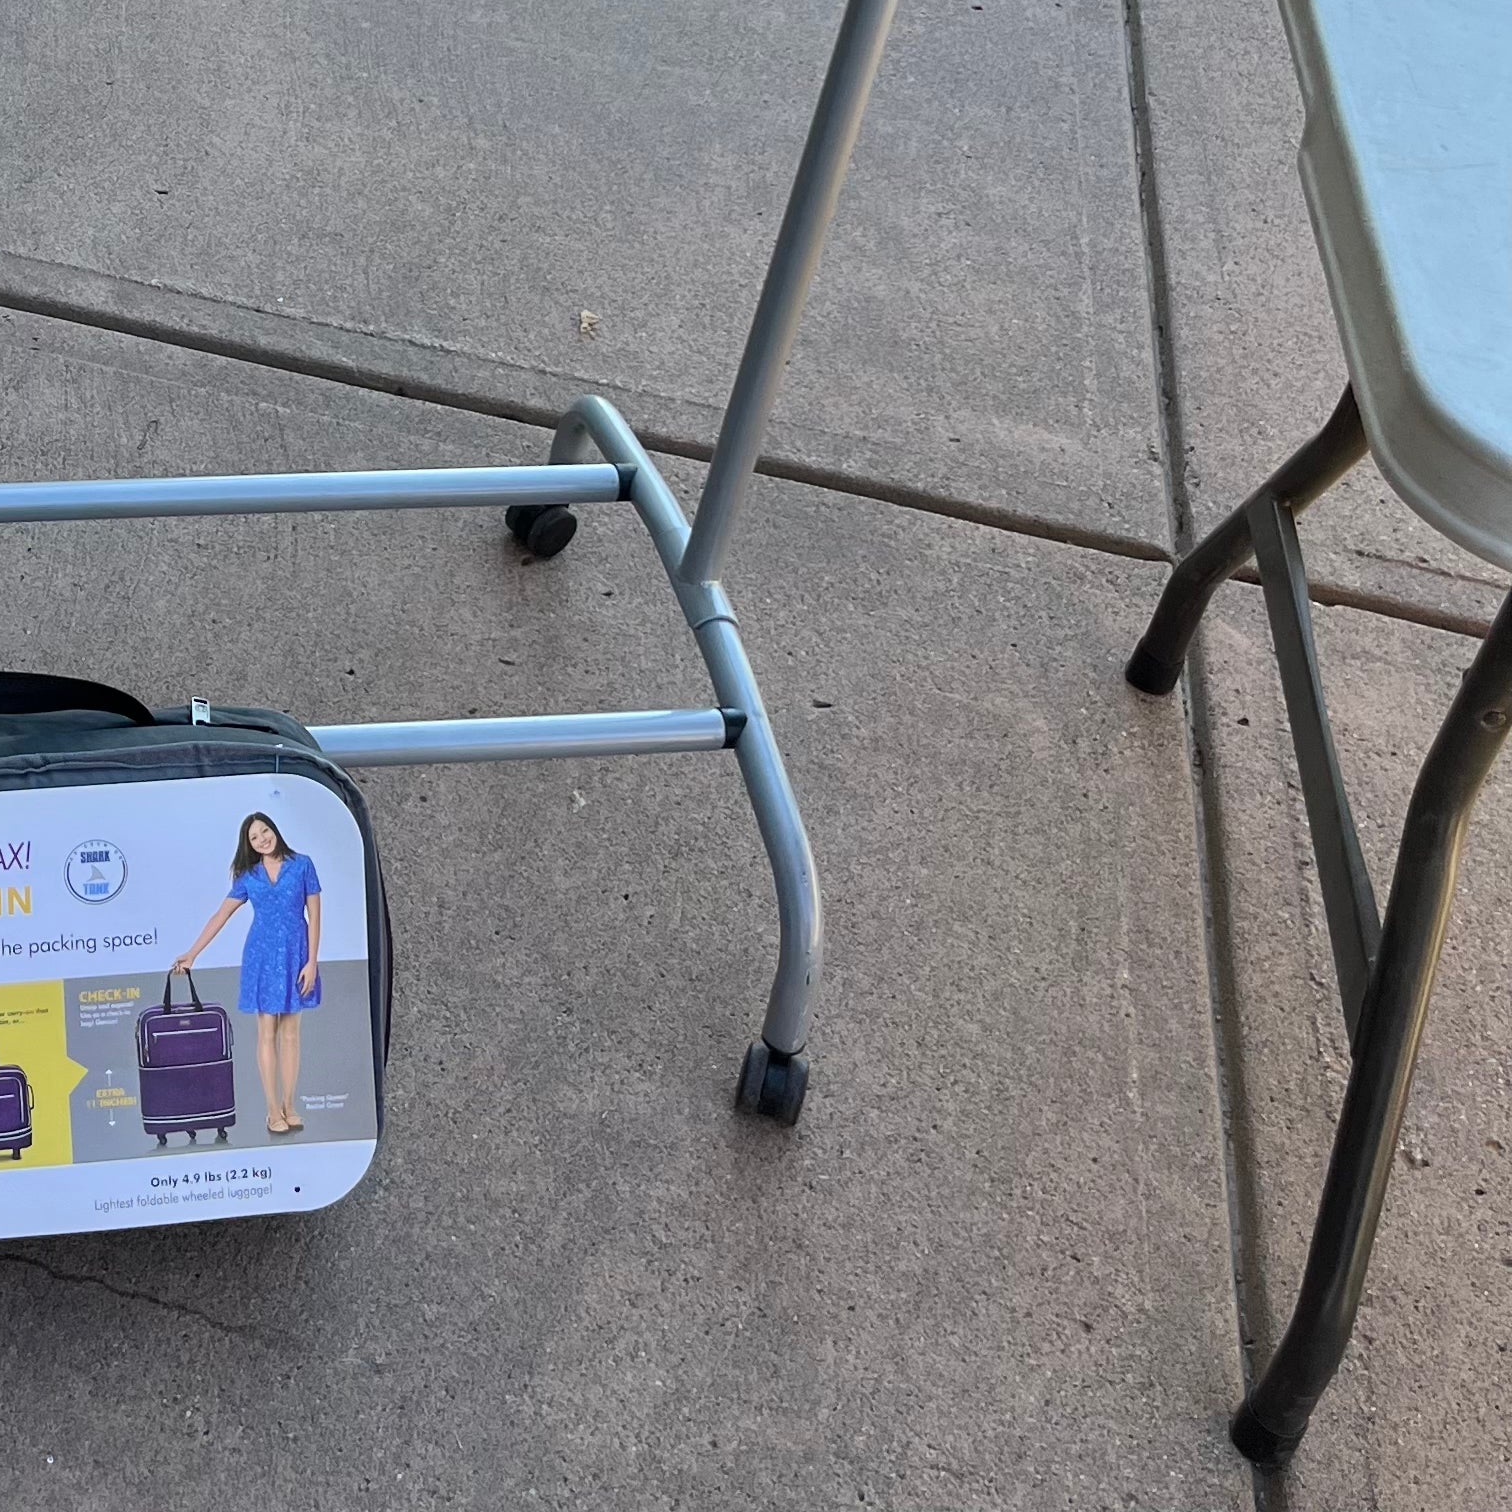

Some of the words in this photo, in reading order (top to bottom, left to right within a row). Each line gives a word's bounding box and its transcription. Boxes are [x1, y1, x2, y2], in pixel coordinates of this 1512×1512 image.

[80, 850, 110, 864] SHARK
[82, 882, 110, 896] TANK
[29, 934, 97, 958] packing
[103, 928, 158, 950] space!
[79, 987, 140, 1003] CHECK-IN
[150, 1175, 178, 1188] Only
[182, 1173, 201, 1184] 4.9
[205, 1171, 222, 1182] lbs
[226, 1168, 249, 1182] (2.2
[252, 1166, 273, 1180] kg)
[94, 1197, 134, 1214] Lightest
[137, 1190, 179, 1208] foldable
[182, 1188, 225, 1203] wheeled
[227, 1183, 273, 1200] luggage!
